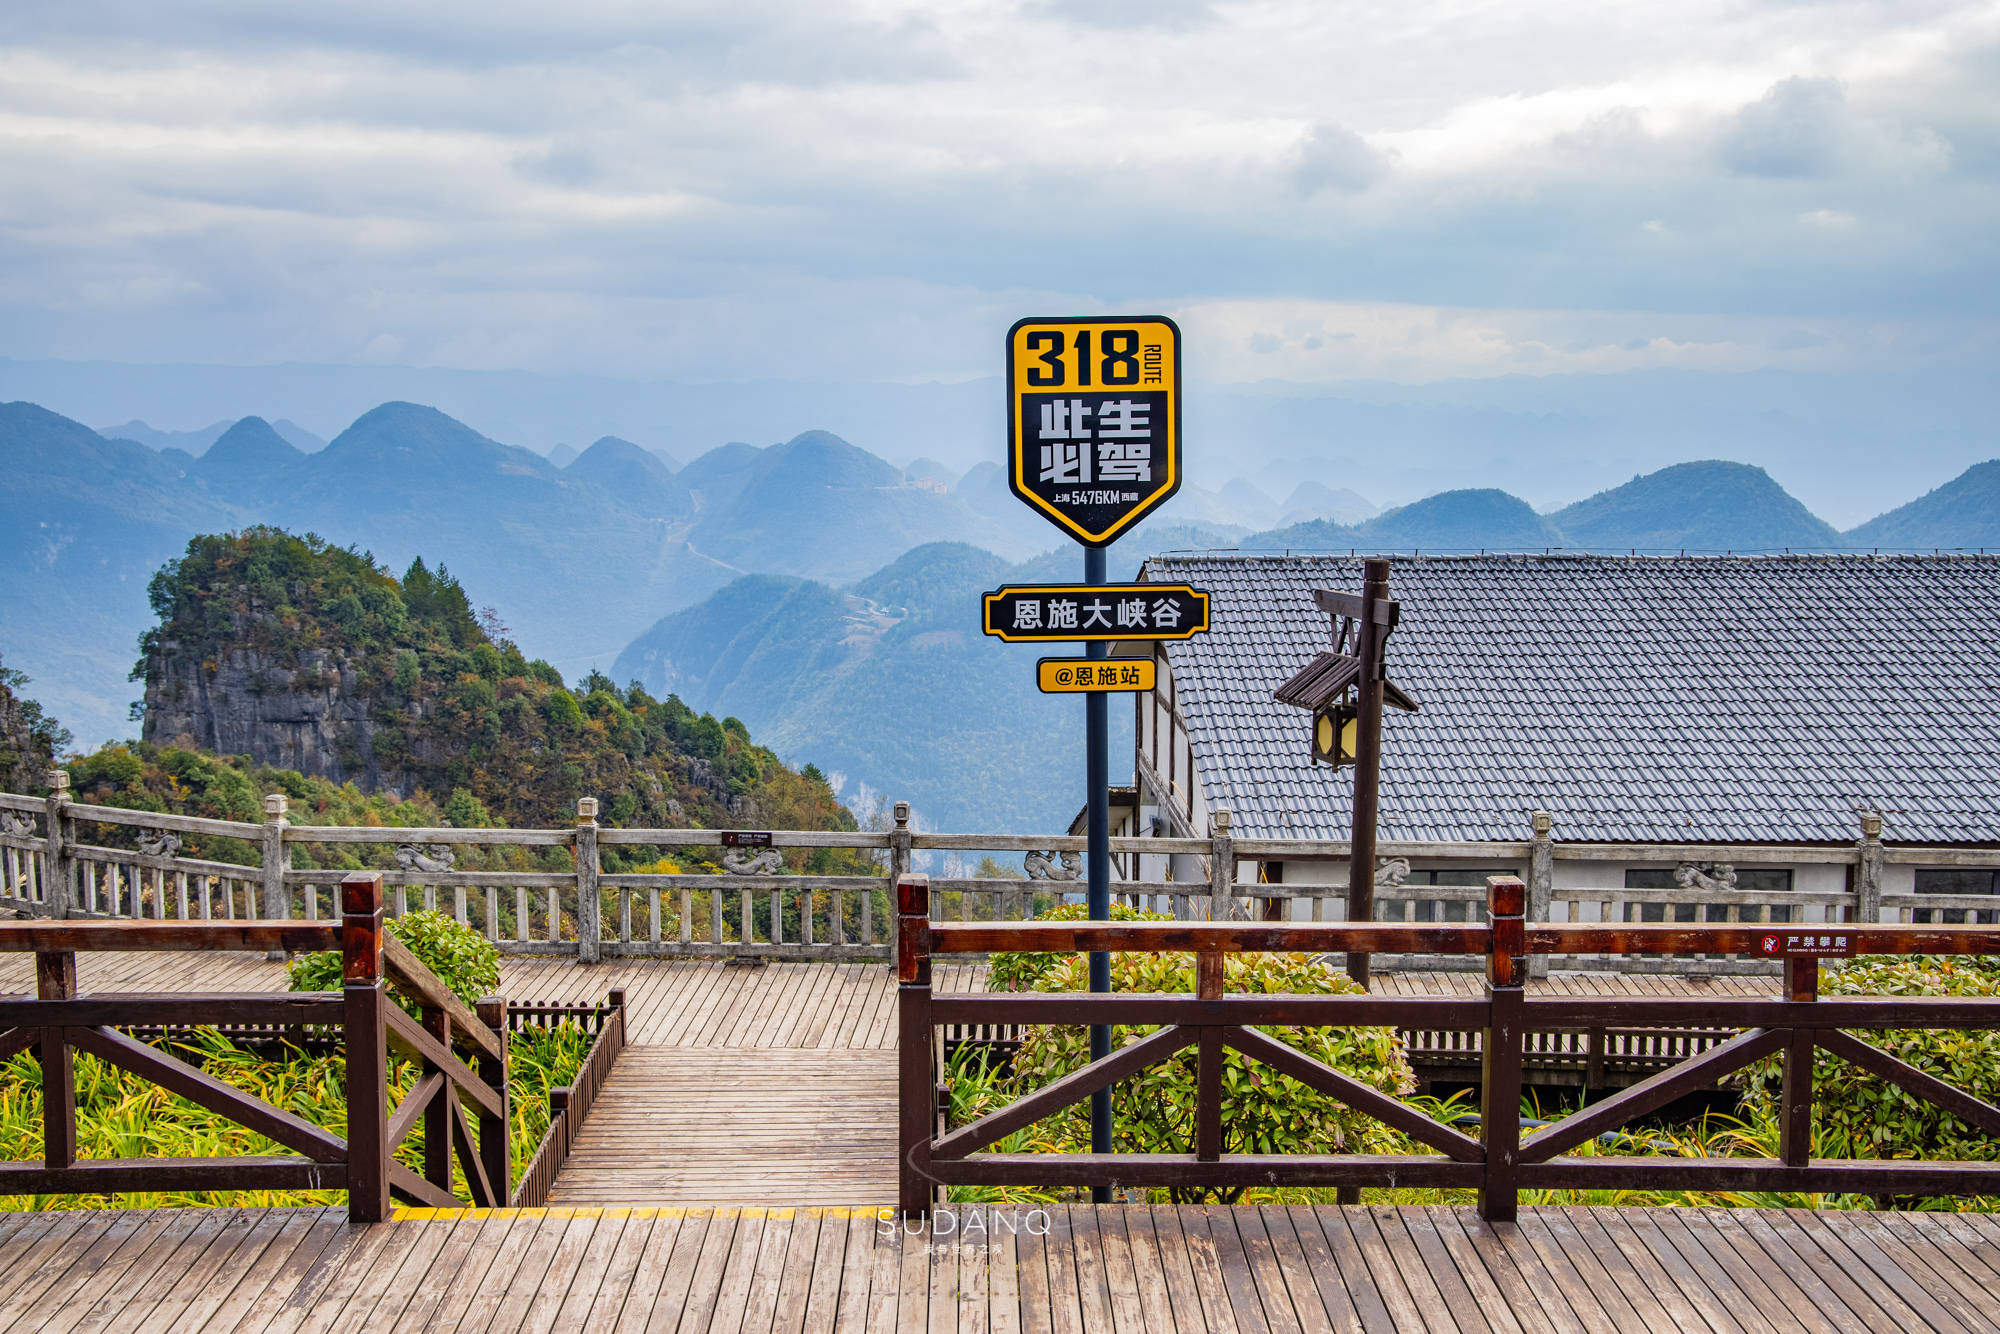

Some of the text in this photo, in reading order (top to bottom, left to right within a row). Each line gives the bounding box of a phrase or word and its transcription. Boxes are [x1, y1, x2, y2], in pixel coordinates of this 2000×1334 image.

[1027, 330, 1139, 386] 318
[1144, 345, 1162, 384] ROUTE
[1039, 400, 1151, 439] 此生
[1039, 442, 1152, 483] 必驾
[1053, 493, 1071, 503] 上海
[1072, 490, 1120, 505] 5476KM
[1012, 598, 1182, 629] 恩施大峡谷
[1055, 666, 1140, 686] @恩施站
[1787, 936, 1847, 947] 严禁攀爬
